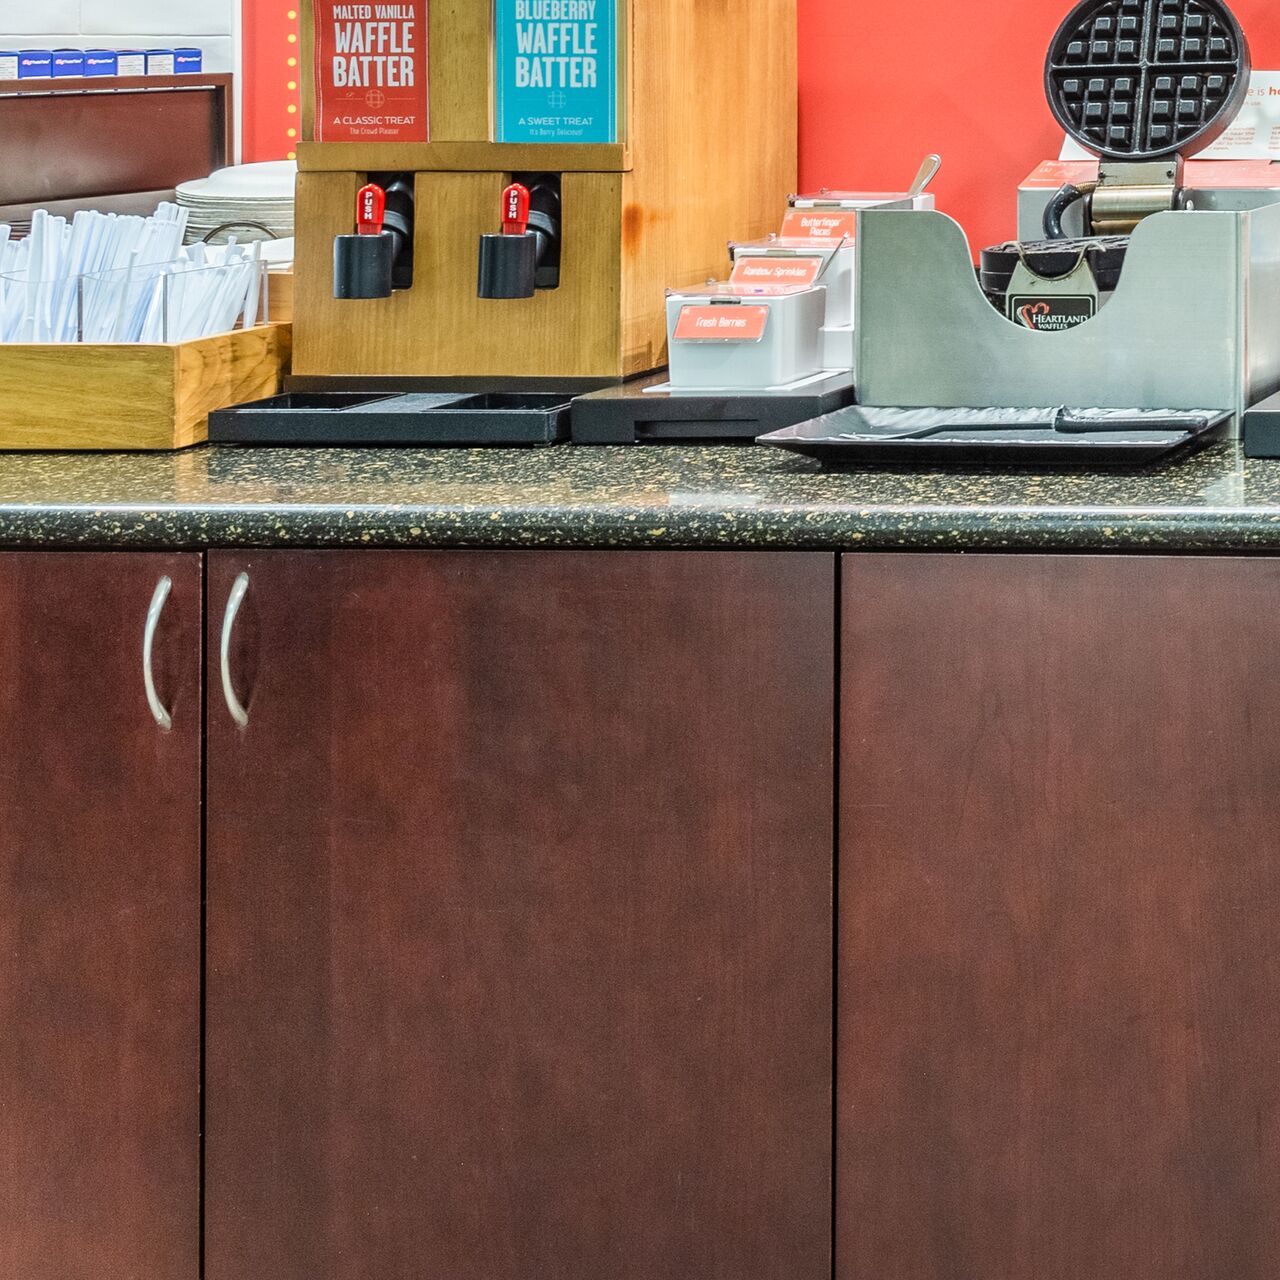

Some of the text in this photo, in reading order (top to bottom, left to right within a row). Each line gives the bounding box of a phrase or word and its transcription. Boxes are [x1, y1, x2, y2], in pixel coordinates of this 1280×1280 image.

[333, 5, 415, 19] MALTED VANILLA
[515, 0, 596, 20] BLUEBERRY
[334, 22, 415, 53] WAFFLE
[516, 22, 597, 54] WAFFLE
[333, 55, 414, 87] BATTER
[515, 57, 597, 88] BATTER
[1257, 88, 1265, 96] is
[333, 116, 416, 125] A CLASSIC TREAT
[518, 117, 593, 125] A SWEET TREAT
[364, 191, 373, 220] PUSH
[508, 190, 517, 219] PUSH
[800, 217, 842, 228] Butterfinger
[774, 266, 807, 278] Sprinkles
[696, 317, 747, 327] Fresh Berries
[1033, 314, 1088, 323] HEARTLAND
